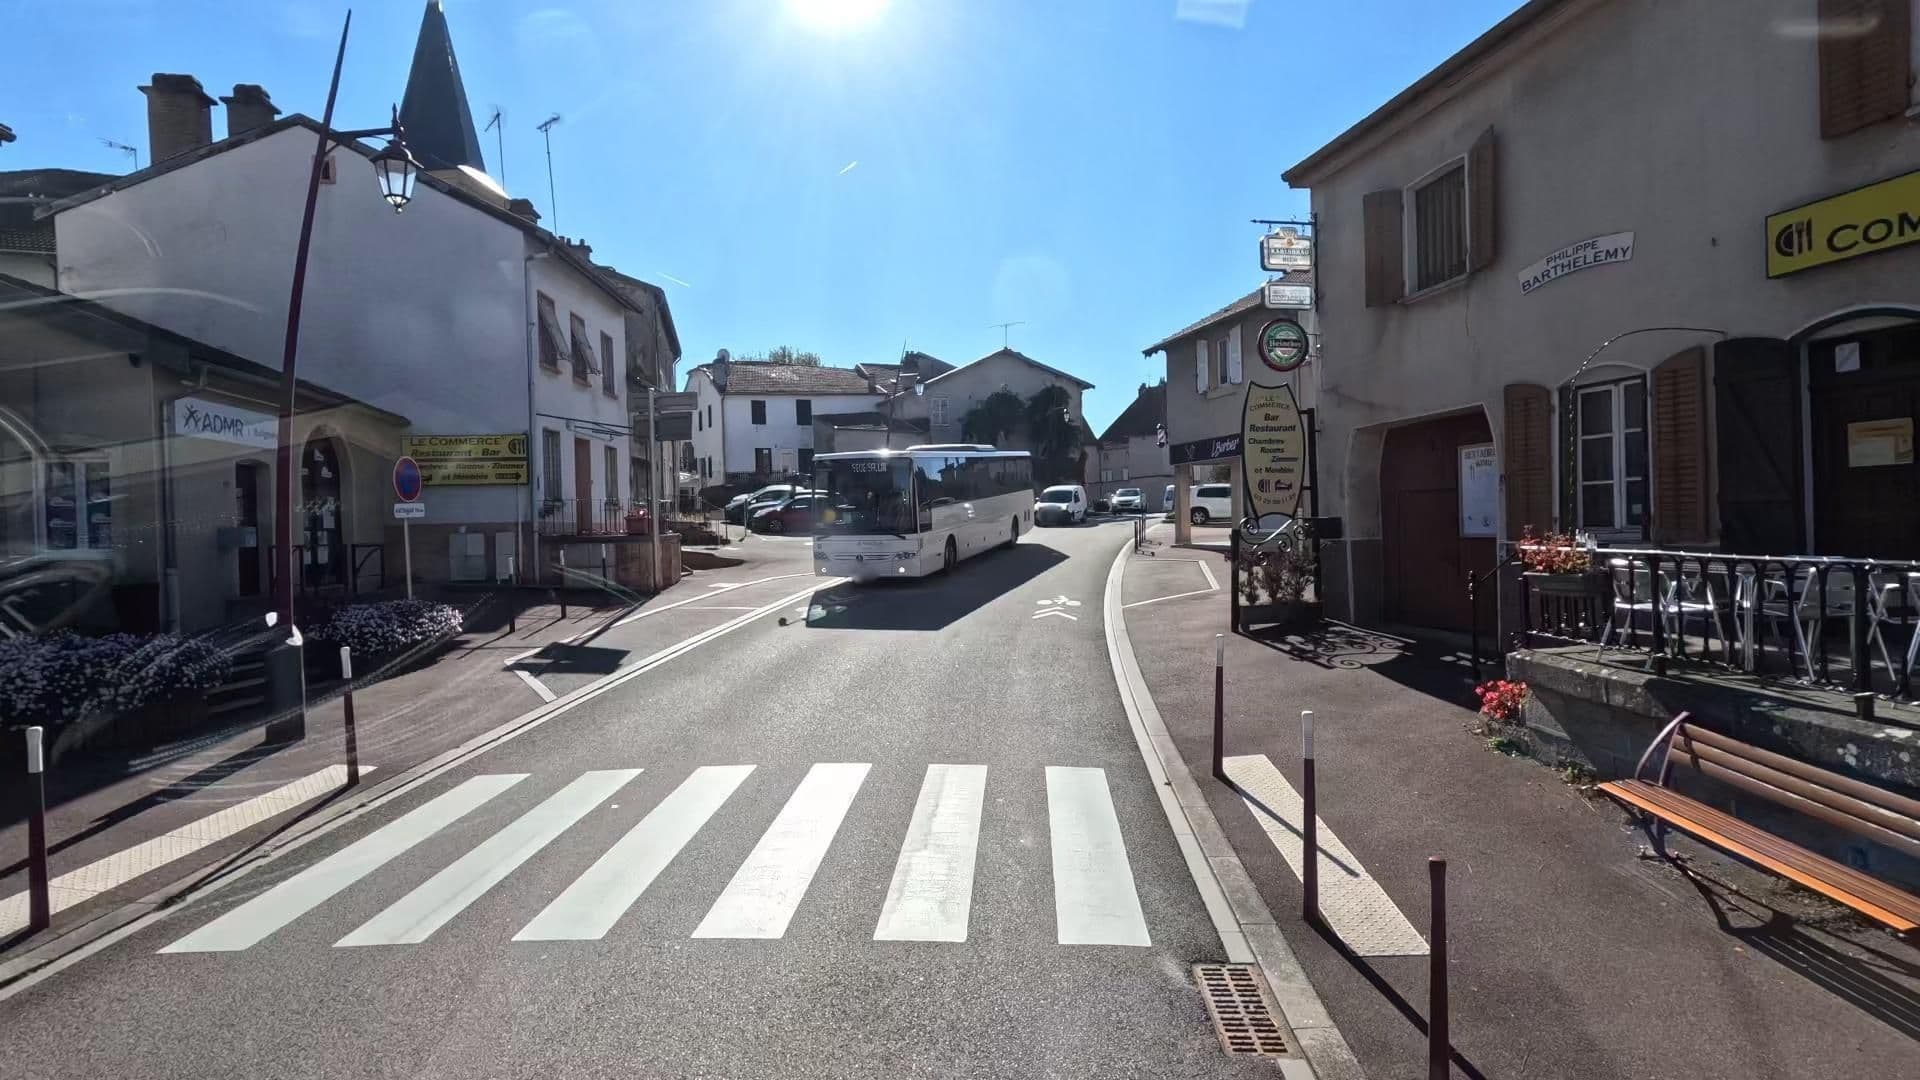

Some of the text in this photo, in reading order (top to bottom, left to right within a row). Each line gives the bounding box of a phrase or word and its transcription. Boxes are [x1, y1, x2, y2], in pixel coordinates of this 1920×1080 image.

[1546, 240, 1599, 266] PHILIPPE
[1522, 246, 1630, 292] BARTHELEMY
[1264, 412, 1280, 422] Bar
[201, 412, 244, 438] ADMR
[1249, 424, 1296, 433] Restaurant
[410, 437, 502, 447] LE COMMERCE
[411, 448, 471, 457] Restaurant
[481, 447, 502, 457] Bar
